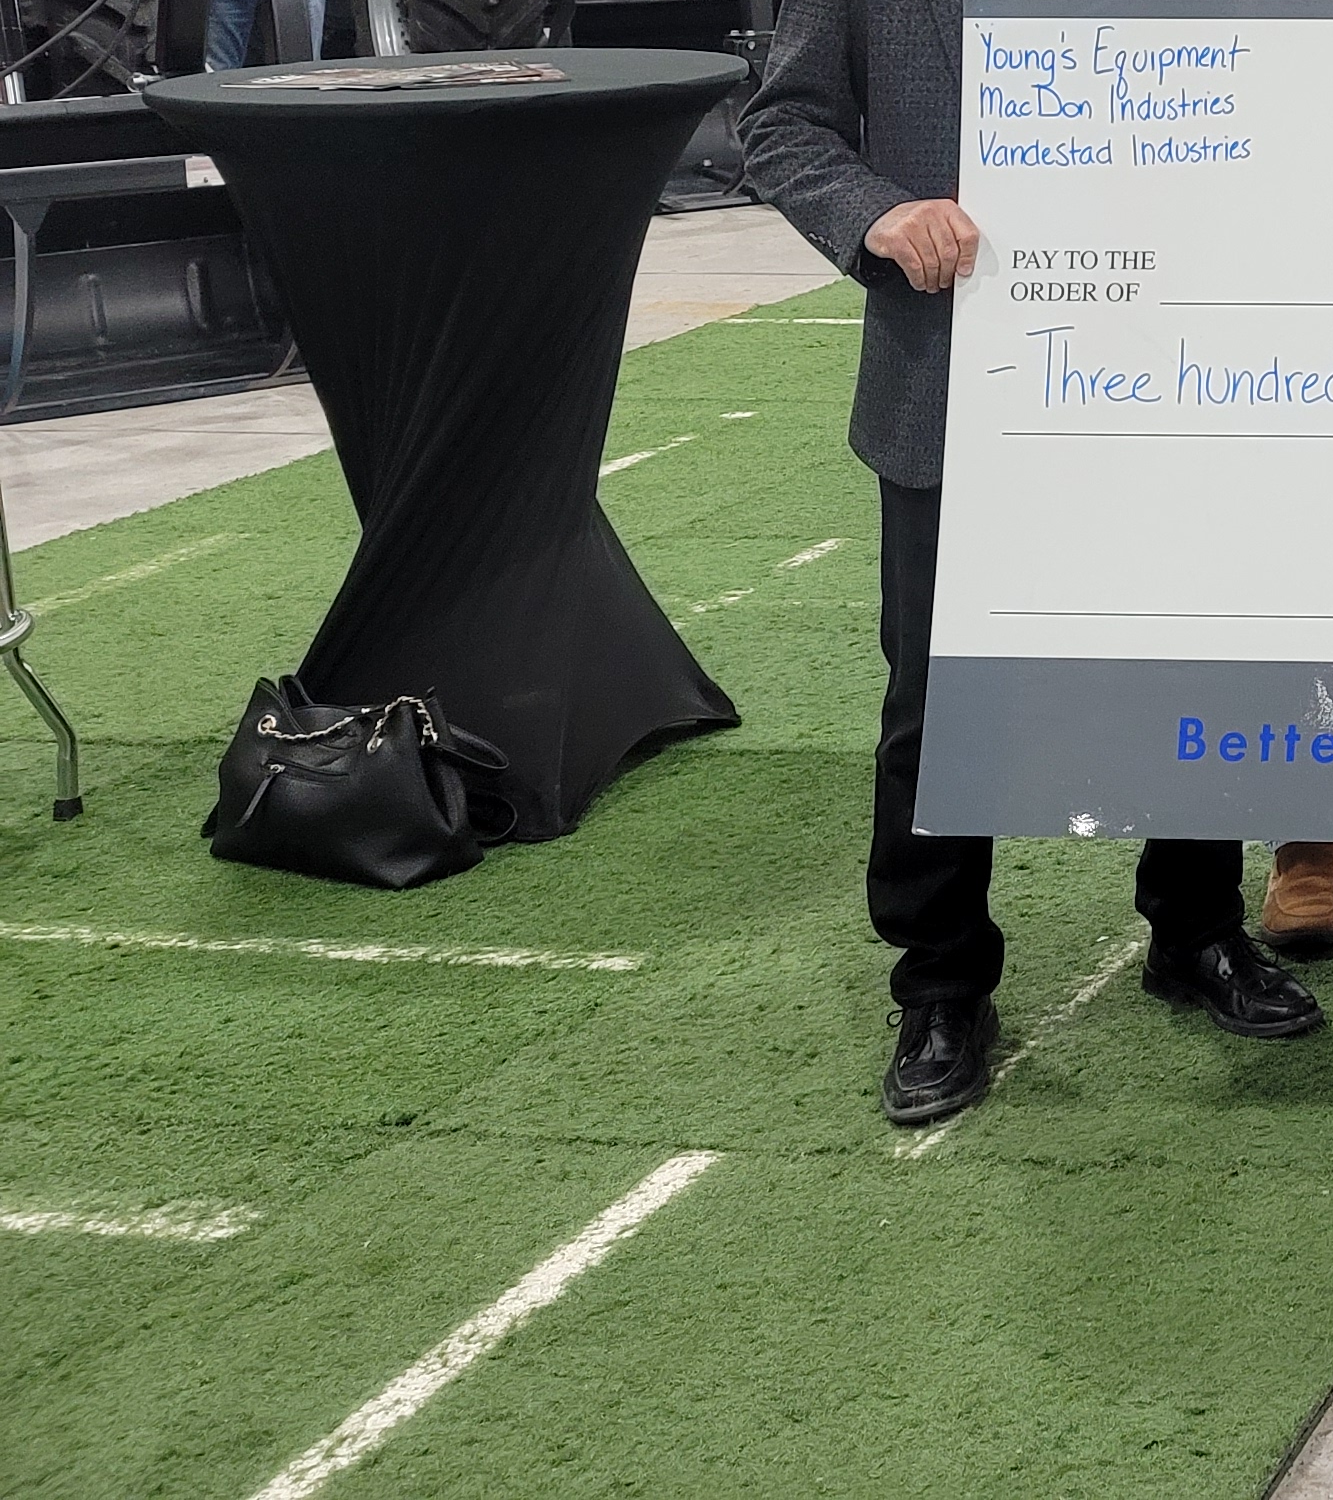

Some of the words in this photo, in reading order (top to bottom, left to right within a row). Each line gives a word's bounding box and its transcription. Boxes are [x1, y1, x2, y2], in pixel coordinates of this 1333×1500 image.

[978, 29, 1078, 87] Young's
[1092, 25, 1251, 100] Equipment
[1110, 81, 1236, 123] Industries
[978, 136, 1113, 168] Vandestad
[1132, 133, 1252, 167] Industries
[1011, 249, 1060, 270] PAY
[1063, 250, 1100, 270] TO
[1104, 250, 1157, 271] THE
[1010, 281, 1099, 303] ORDER
[1105, 282, 1141, 303] OF
[1026, 326, 1162, 407] Three
